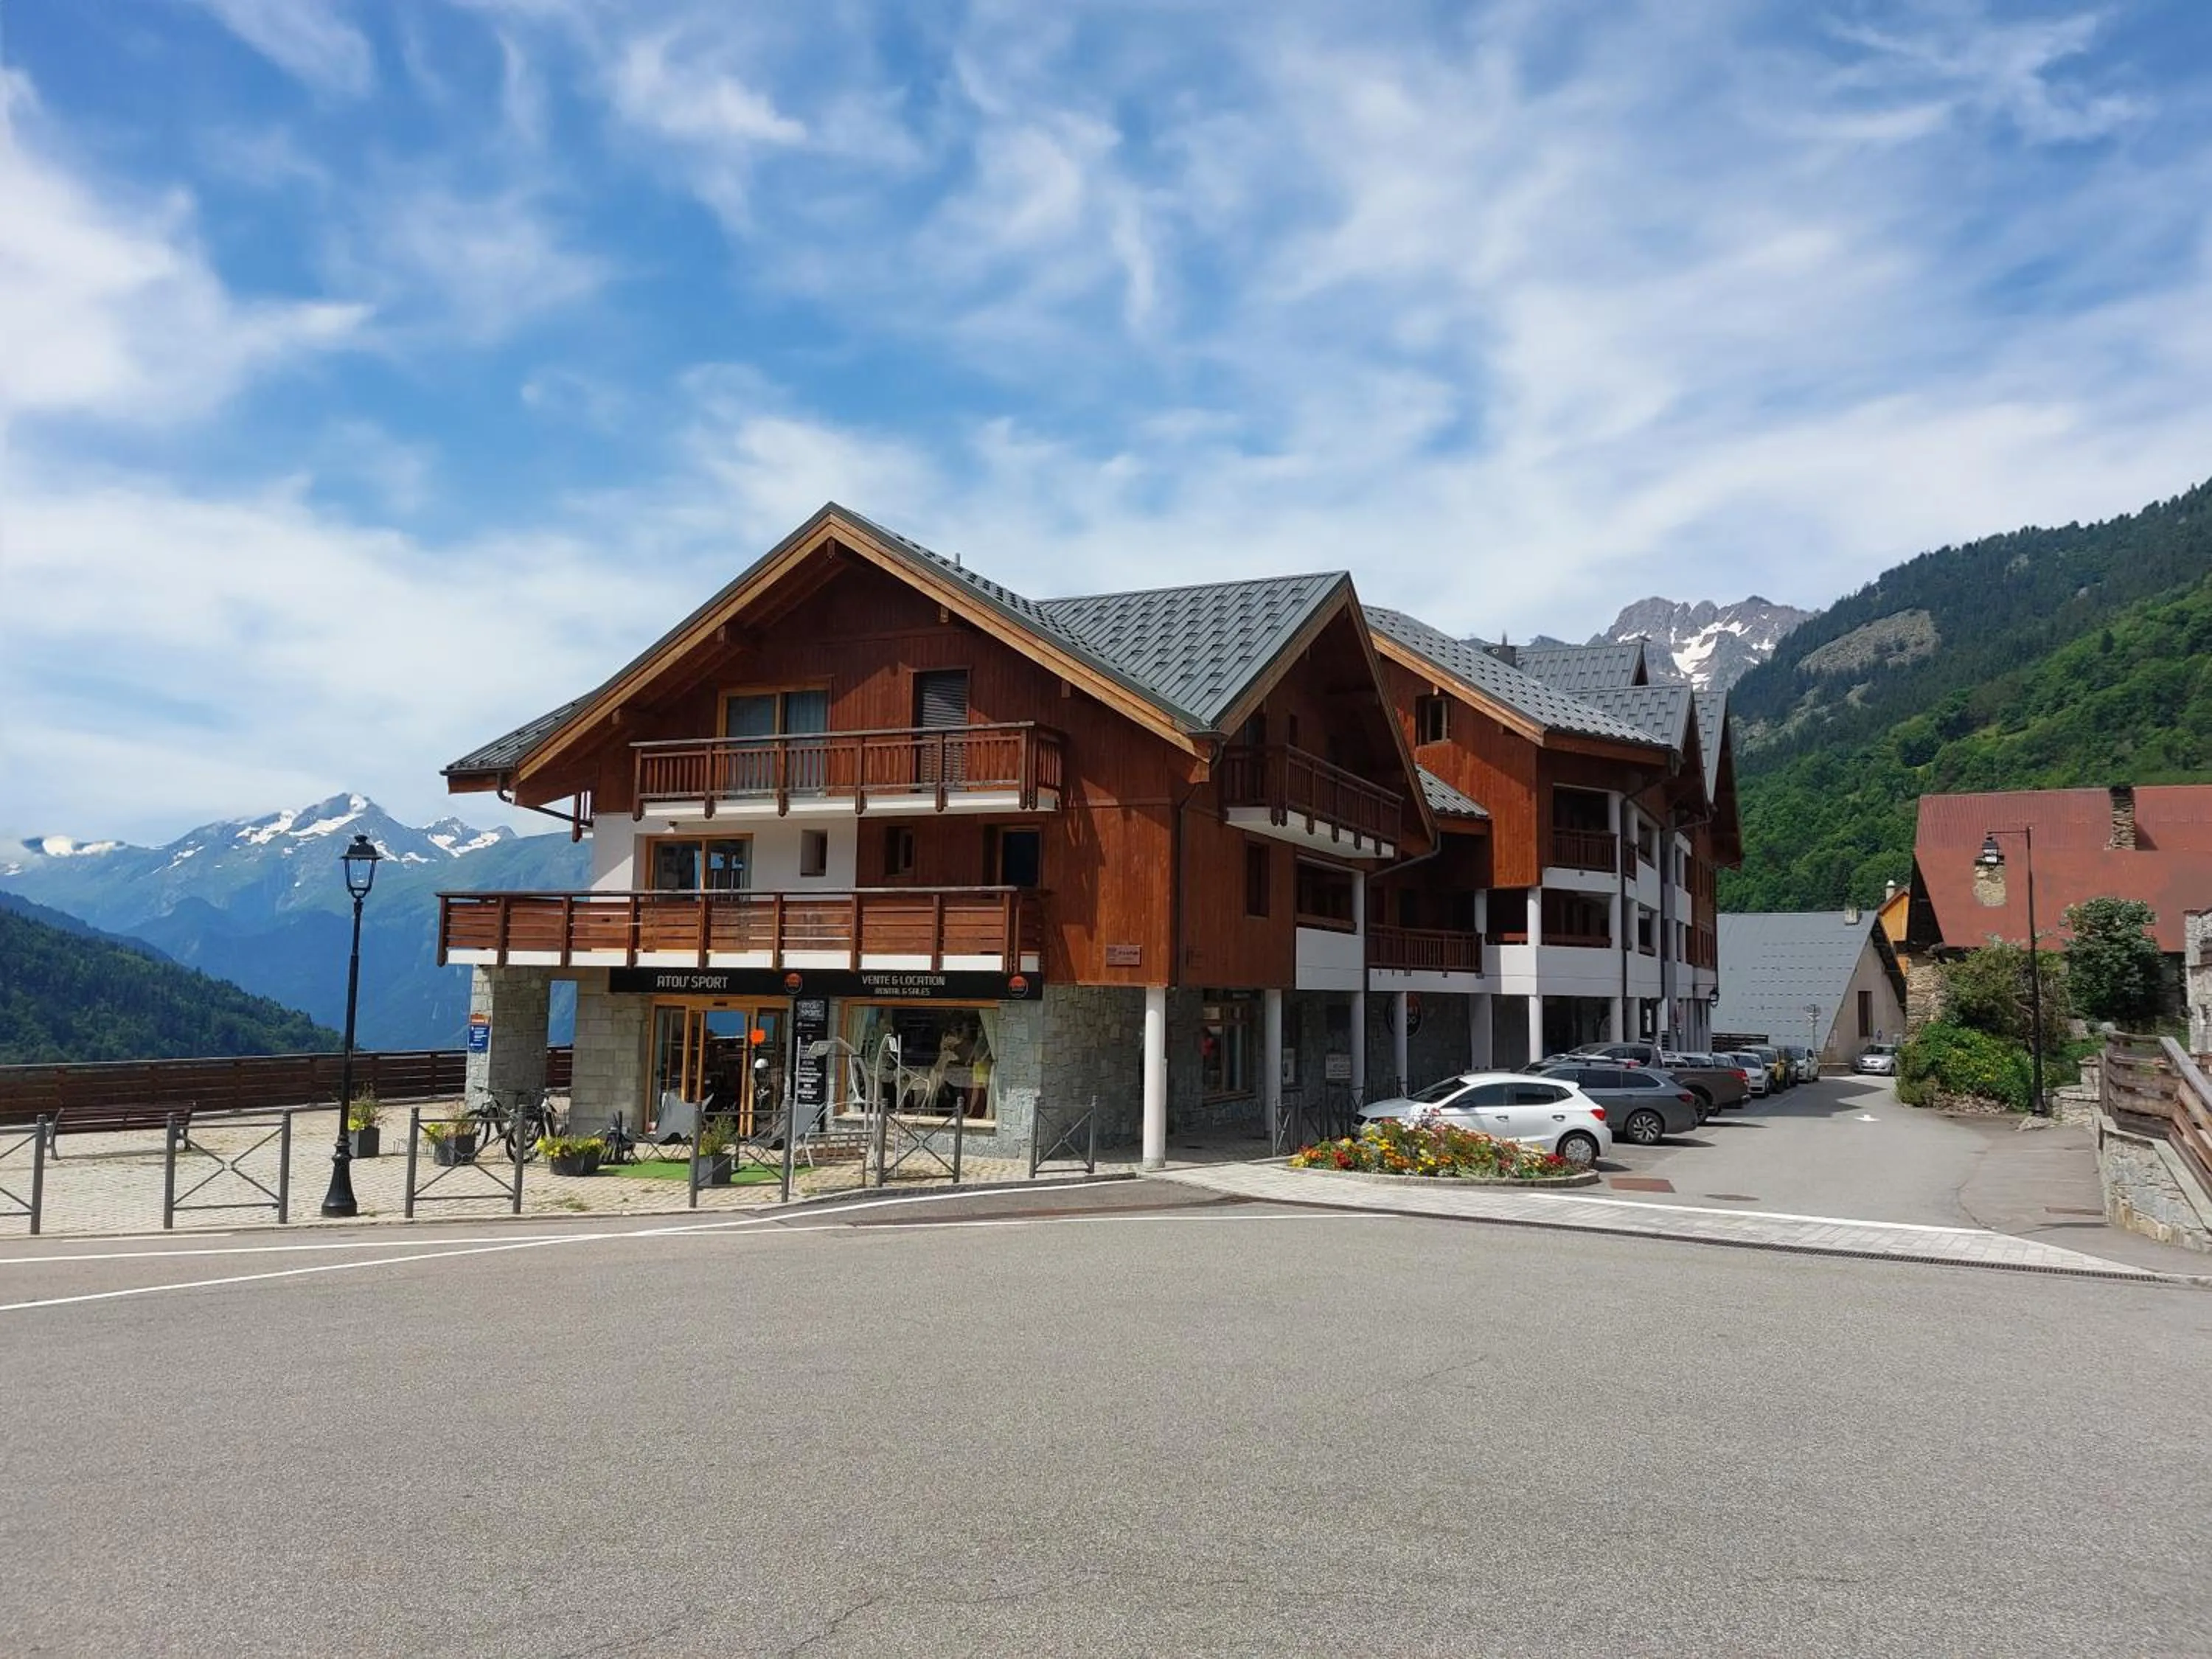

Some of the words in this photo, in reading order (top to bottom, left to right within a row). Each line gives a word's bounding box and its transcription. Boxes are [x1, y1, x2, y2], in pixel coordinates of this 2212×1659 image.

[690, 975, 728, 989] SPORT
[861, 975, 890, 985] VENTE
[900, 975, 945, 986] LOCATION
